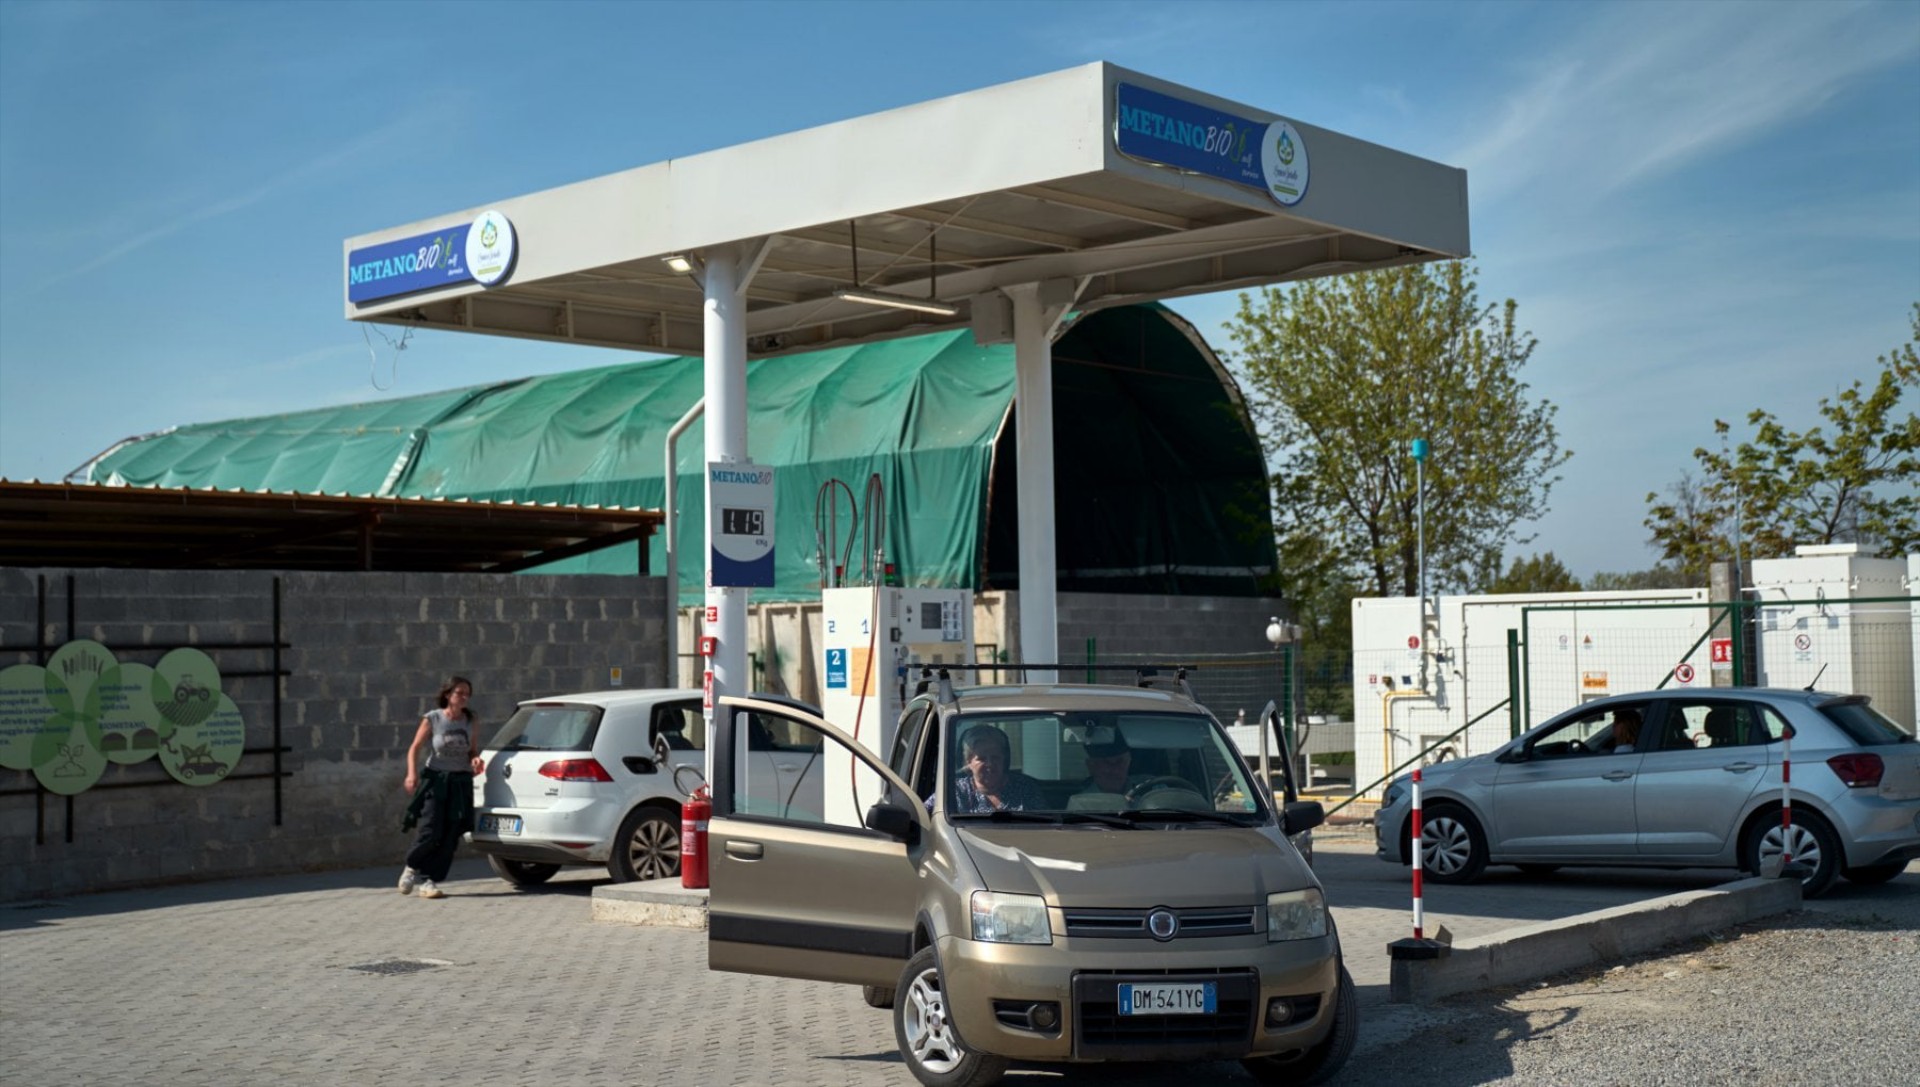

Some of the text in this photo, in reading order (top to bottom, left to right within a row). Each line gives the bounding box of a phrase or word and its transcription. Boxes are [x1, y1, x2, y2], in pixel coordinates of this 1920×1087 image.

[828, 620, 836, 633] 2
[861, 619, 869, 634] 1
[831, 650, 841, 666] 2
